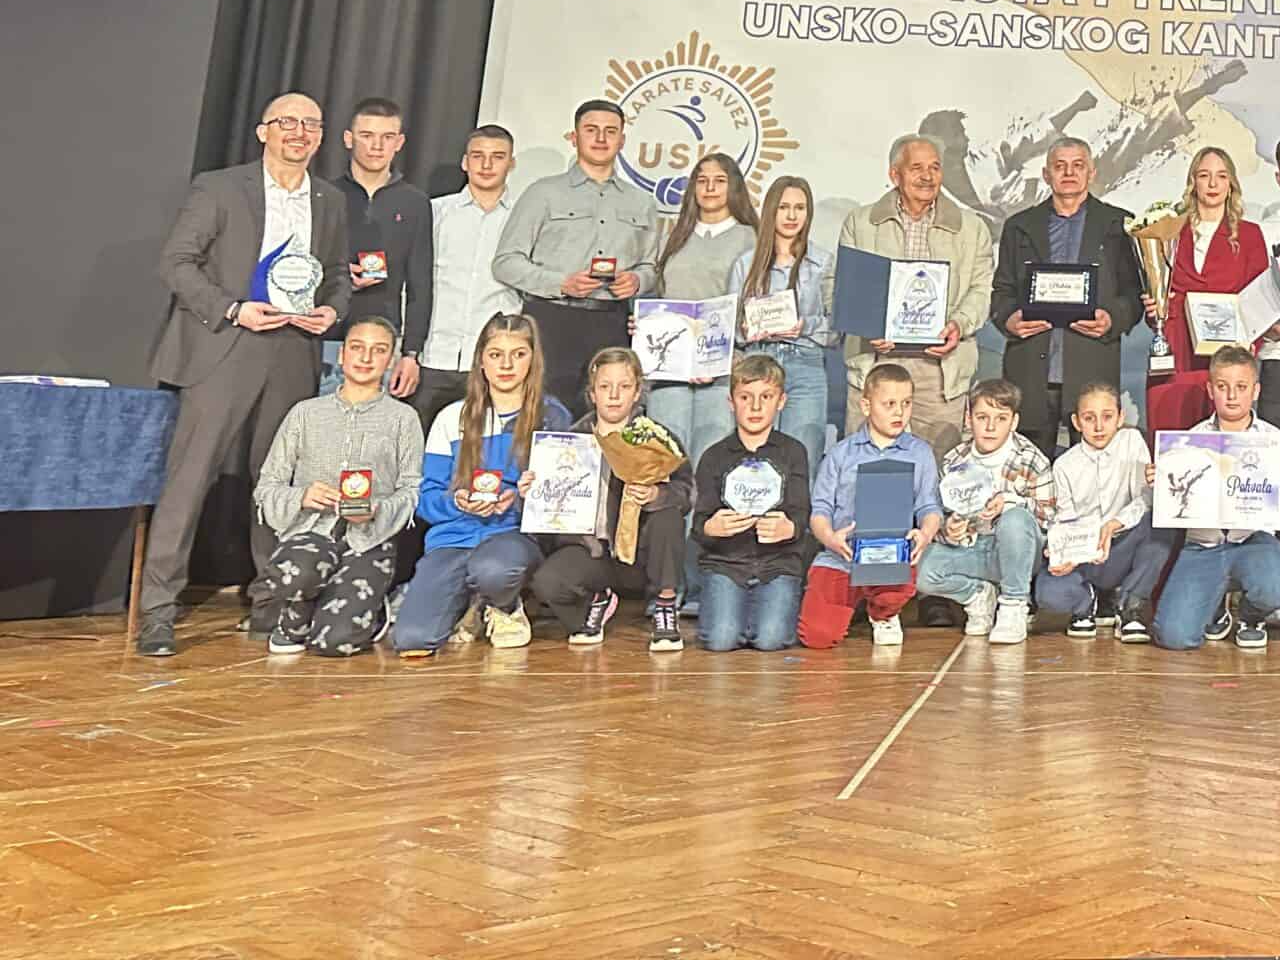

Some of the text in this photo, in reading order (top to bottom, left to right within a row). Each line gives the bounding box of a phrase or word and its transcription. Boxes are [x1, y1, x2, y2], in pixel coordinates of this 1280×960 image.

[743, 2, 1150, 54] UNSKO-SANSKOG
[624, 77, 748, 130] KARATE SAVEZ
[1226, 475, 1273, 497] Pohvala
